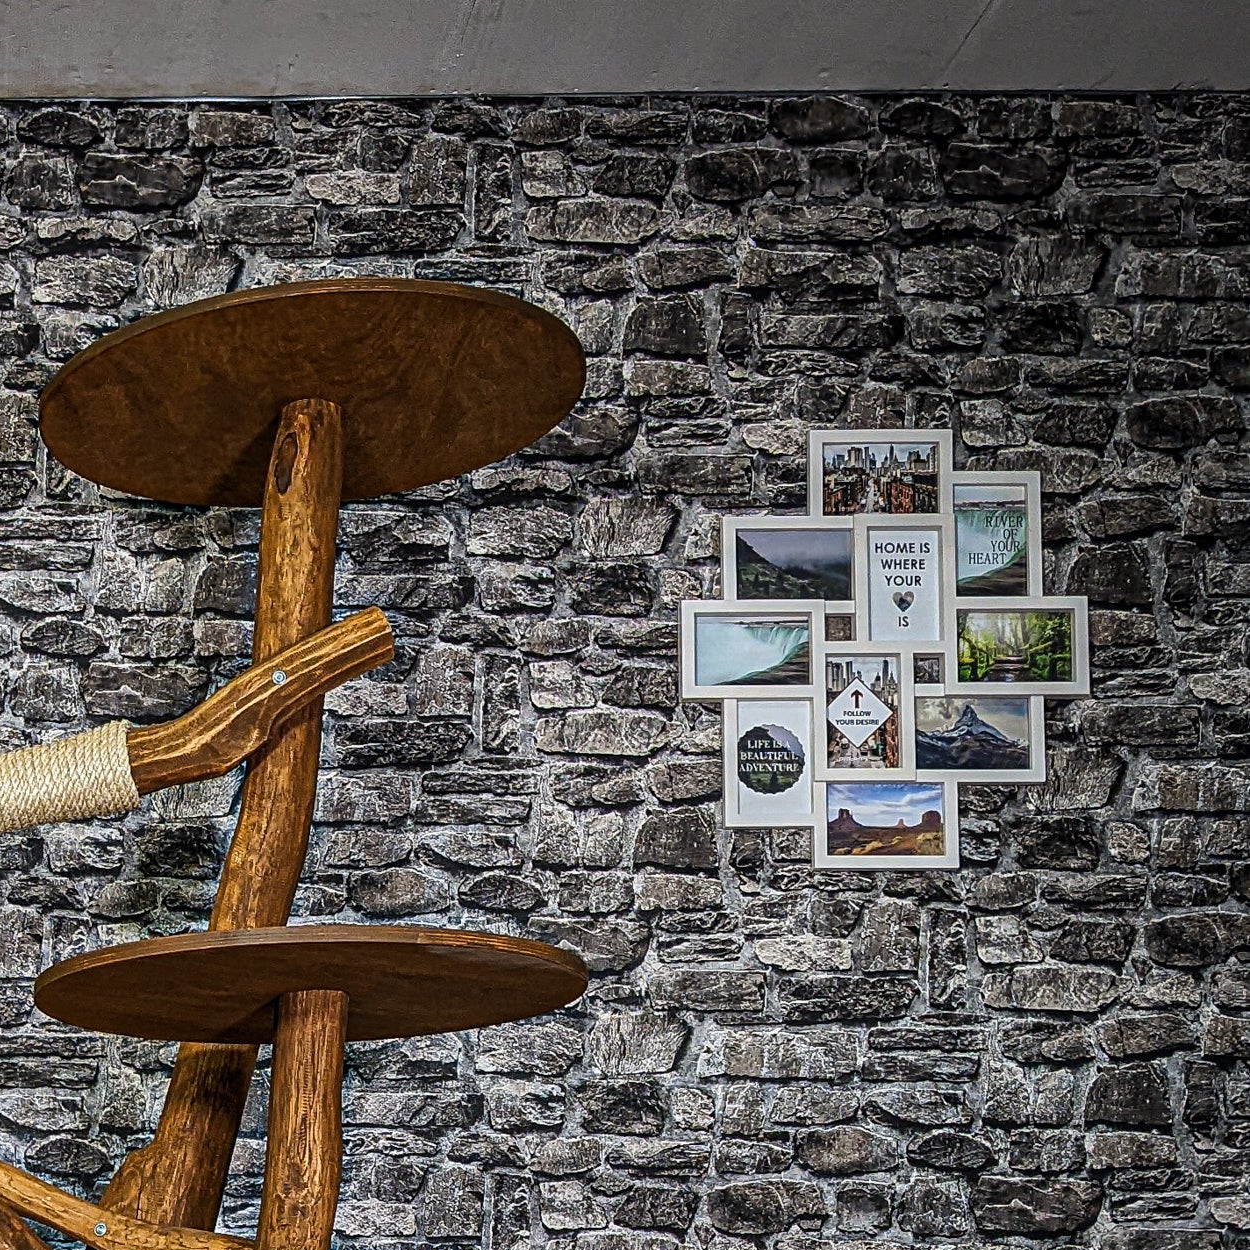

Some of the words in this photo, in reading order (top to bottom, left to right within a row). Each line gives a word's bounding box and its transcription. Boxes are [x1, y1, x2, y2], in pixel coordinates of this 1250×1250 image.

[985, 515, 1024, 528] RIVER
[1003, 528, 1019, 541] OF
[874, 542, 916, 554] HOME
[919, 542, 931, 554] IS
[991, 540, 1020, 553] YOUR
[881, 558, 926, 570] WHERE
[968, 552, 1007, 565] HEART
[885, 575, 922, 587] YOUR
[898, 616, 910, 627] IS
[747, 740, 771, 749] LIFE
[773, 740, 783, 749] IS
[740, 751, 799, 761] BEAUTIFUL
[739, 763, 800, 772] ADVENTURE
